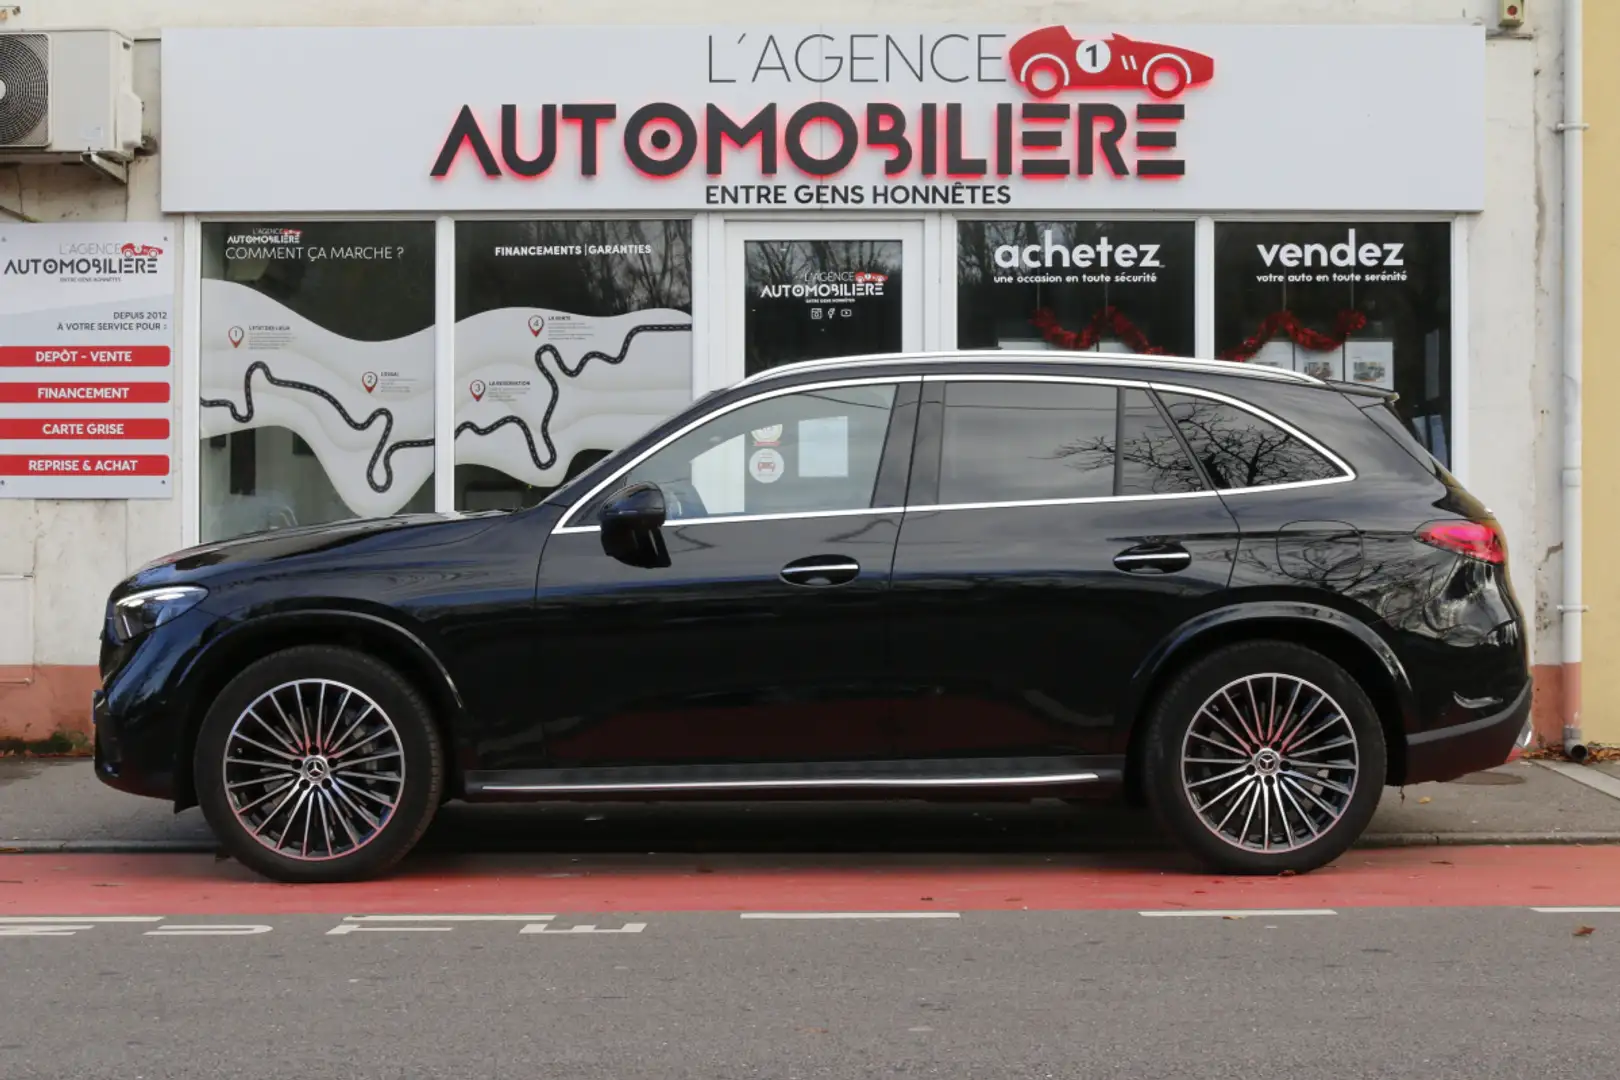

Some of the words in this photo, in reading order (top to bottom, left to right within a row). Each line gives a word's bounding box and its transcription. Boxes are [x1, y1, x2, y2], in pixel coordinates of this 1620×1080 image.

[708, 33, 1007, 83] L'AGENCE
[1085, 43, 1098, 68] 1
[430, 102, 1185, 177] AUTOMOBILIERE
[705, 185, 787, 204] ENTRE
[794, 184, 865, 204] GENS
[872, 182, 1011, 204] HONNÊTES
[59, 243, 121, 256] L'AGENCE
[495, 245, 582, 257] FINANCEMENTS
[588, 244, 652, 255] GARANTIES
[994, 230, 1161, 268] achetez
[1256, 228, 1404, 267] vendez
[225, 247, 304, 260] COMMENT
[307, 247, 327, 262] ÇA
[330, 247, 393, 260] MARCHE
[397, 247, 404, 259] ?
[4, 258, 158, 275] AUTOMOBILIERE
[804, 272, 855, 282] L'AGENCE
[993, 275, 1013, 283] une
[1017, 273, 1062, 283] occasion
[1066, 275, 1079, 283] en
[1083, 274, 1111, 283] toute
[1114, 272, 1157, 283] sécurité
[1256, 273, 1285, 282] votre
[1288, 273, 1313, 282] auto
[1316, 274, 1329, 282] en
[1333, 272, 1361, 282] toute
[760, 283, 884, 298] AUTOMOBILIERE
[113, 311, 145, 319] DEPUIS
[146, 311, 168, 319] 2012
[57, 322, 63, 331] À
[65, 322, 95, 331] VOTRE
[97, 322, 133, 331] SERVICE
[136, 322, 160, 331] POUR
[90, 350, 132, 362] VENTE
[37, 387, 130, 399] FINANCEMENT
[42, 423, 84, 435] CARTE
[86, 423, 124, 435] GRISE
[28, 460, 80, 471] REPRISE
[82, 460, 91, 471] &
[95, 460, 138, 471] ACHAT
